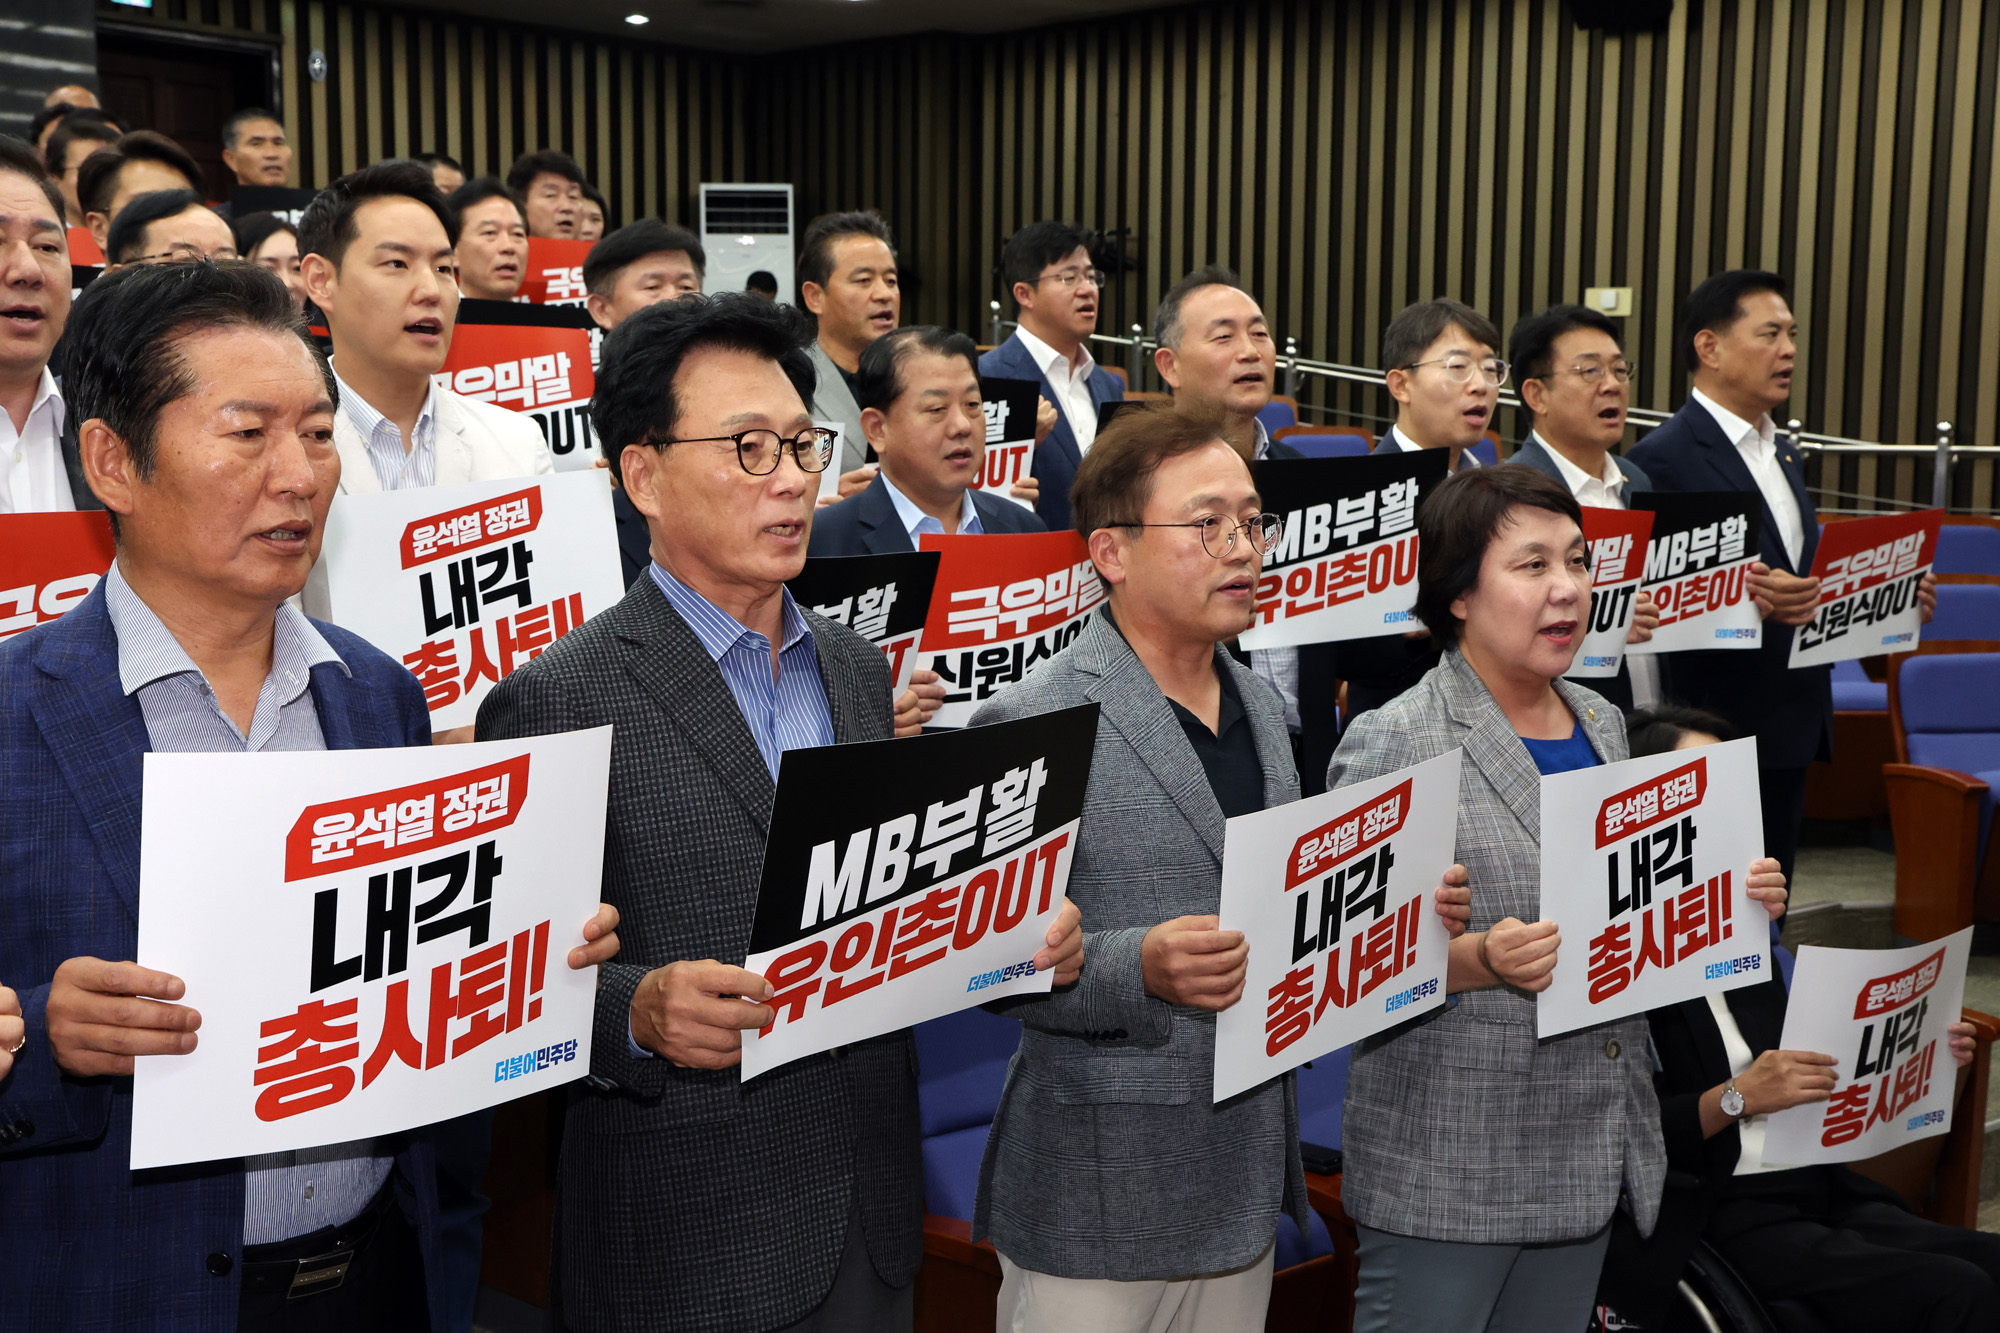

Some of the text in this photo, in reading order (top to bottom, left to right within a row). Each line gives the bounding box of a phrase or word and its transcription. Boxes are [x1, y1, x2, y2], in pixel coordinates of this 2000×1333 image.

[412, 497, 531, 559] 윤석열 정권
[1263, 477, 1419, 566] MB부활
[1644, 514, 1747, 582] MB부활
[1820, 529, 1926, 597] 극우막말
[419, 540, 534, 637] 내각
[948, 559, 1105, 641] 극우막말
[1641, 561, 1759, 628] 인촌OU
[1799, 570, 1928, 652] 신원식OUT
[403, 592, 584, 712] 총사퇴!
[310, 774, 510, 864] 윤석열 정권
[800, 757, 1048, 930] MB부활
[1297, 794, 1401, 877] 윤석열 정권
[1604, 770, 1698, 837] 윤석열 정권
[1292, 842, 1395, 965] 내각
[1608, 815, 1697, 921] 내각
[309, 840, 503, 994] 내각
[757, 831, 1070, 1040] 유인촌OUT
[1587, 869, 1733, 1005] 총사퇴!
[966, 960, 1037, 993] 더불어민주당
[1265, 894, 1422, 1058] 총사퇴!
[1385, 977, 1439, 1014] 더불어민주당
[1705, 954, 1762, 980] 더불어민주당
[1865, 972, 1915, 1011] 윤석열
[254, 919, 551, 1122] 총사퇴!
[495, 1038, 579, 1083] 더불어민주당
[1854, 996, 1929, 1081] 내각
[1821, 1038, 1937, 1148] 총사퇴!
